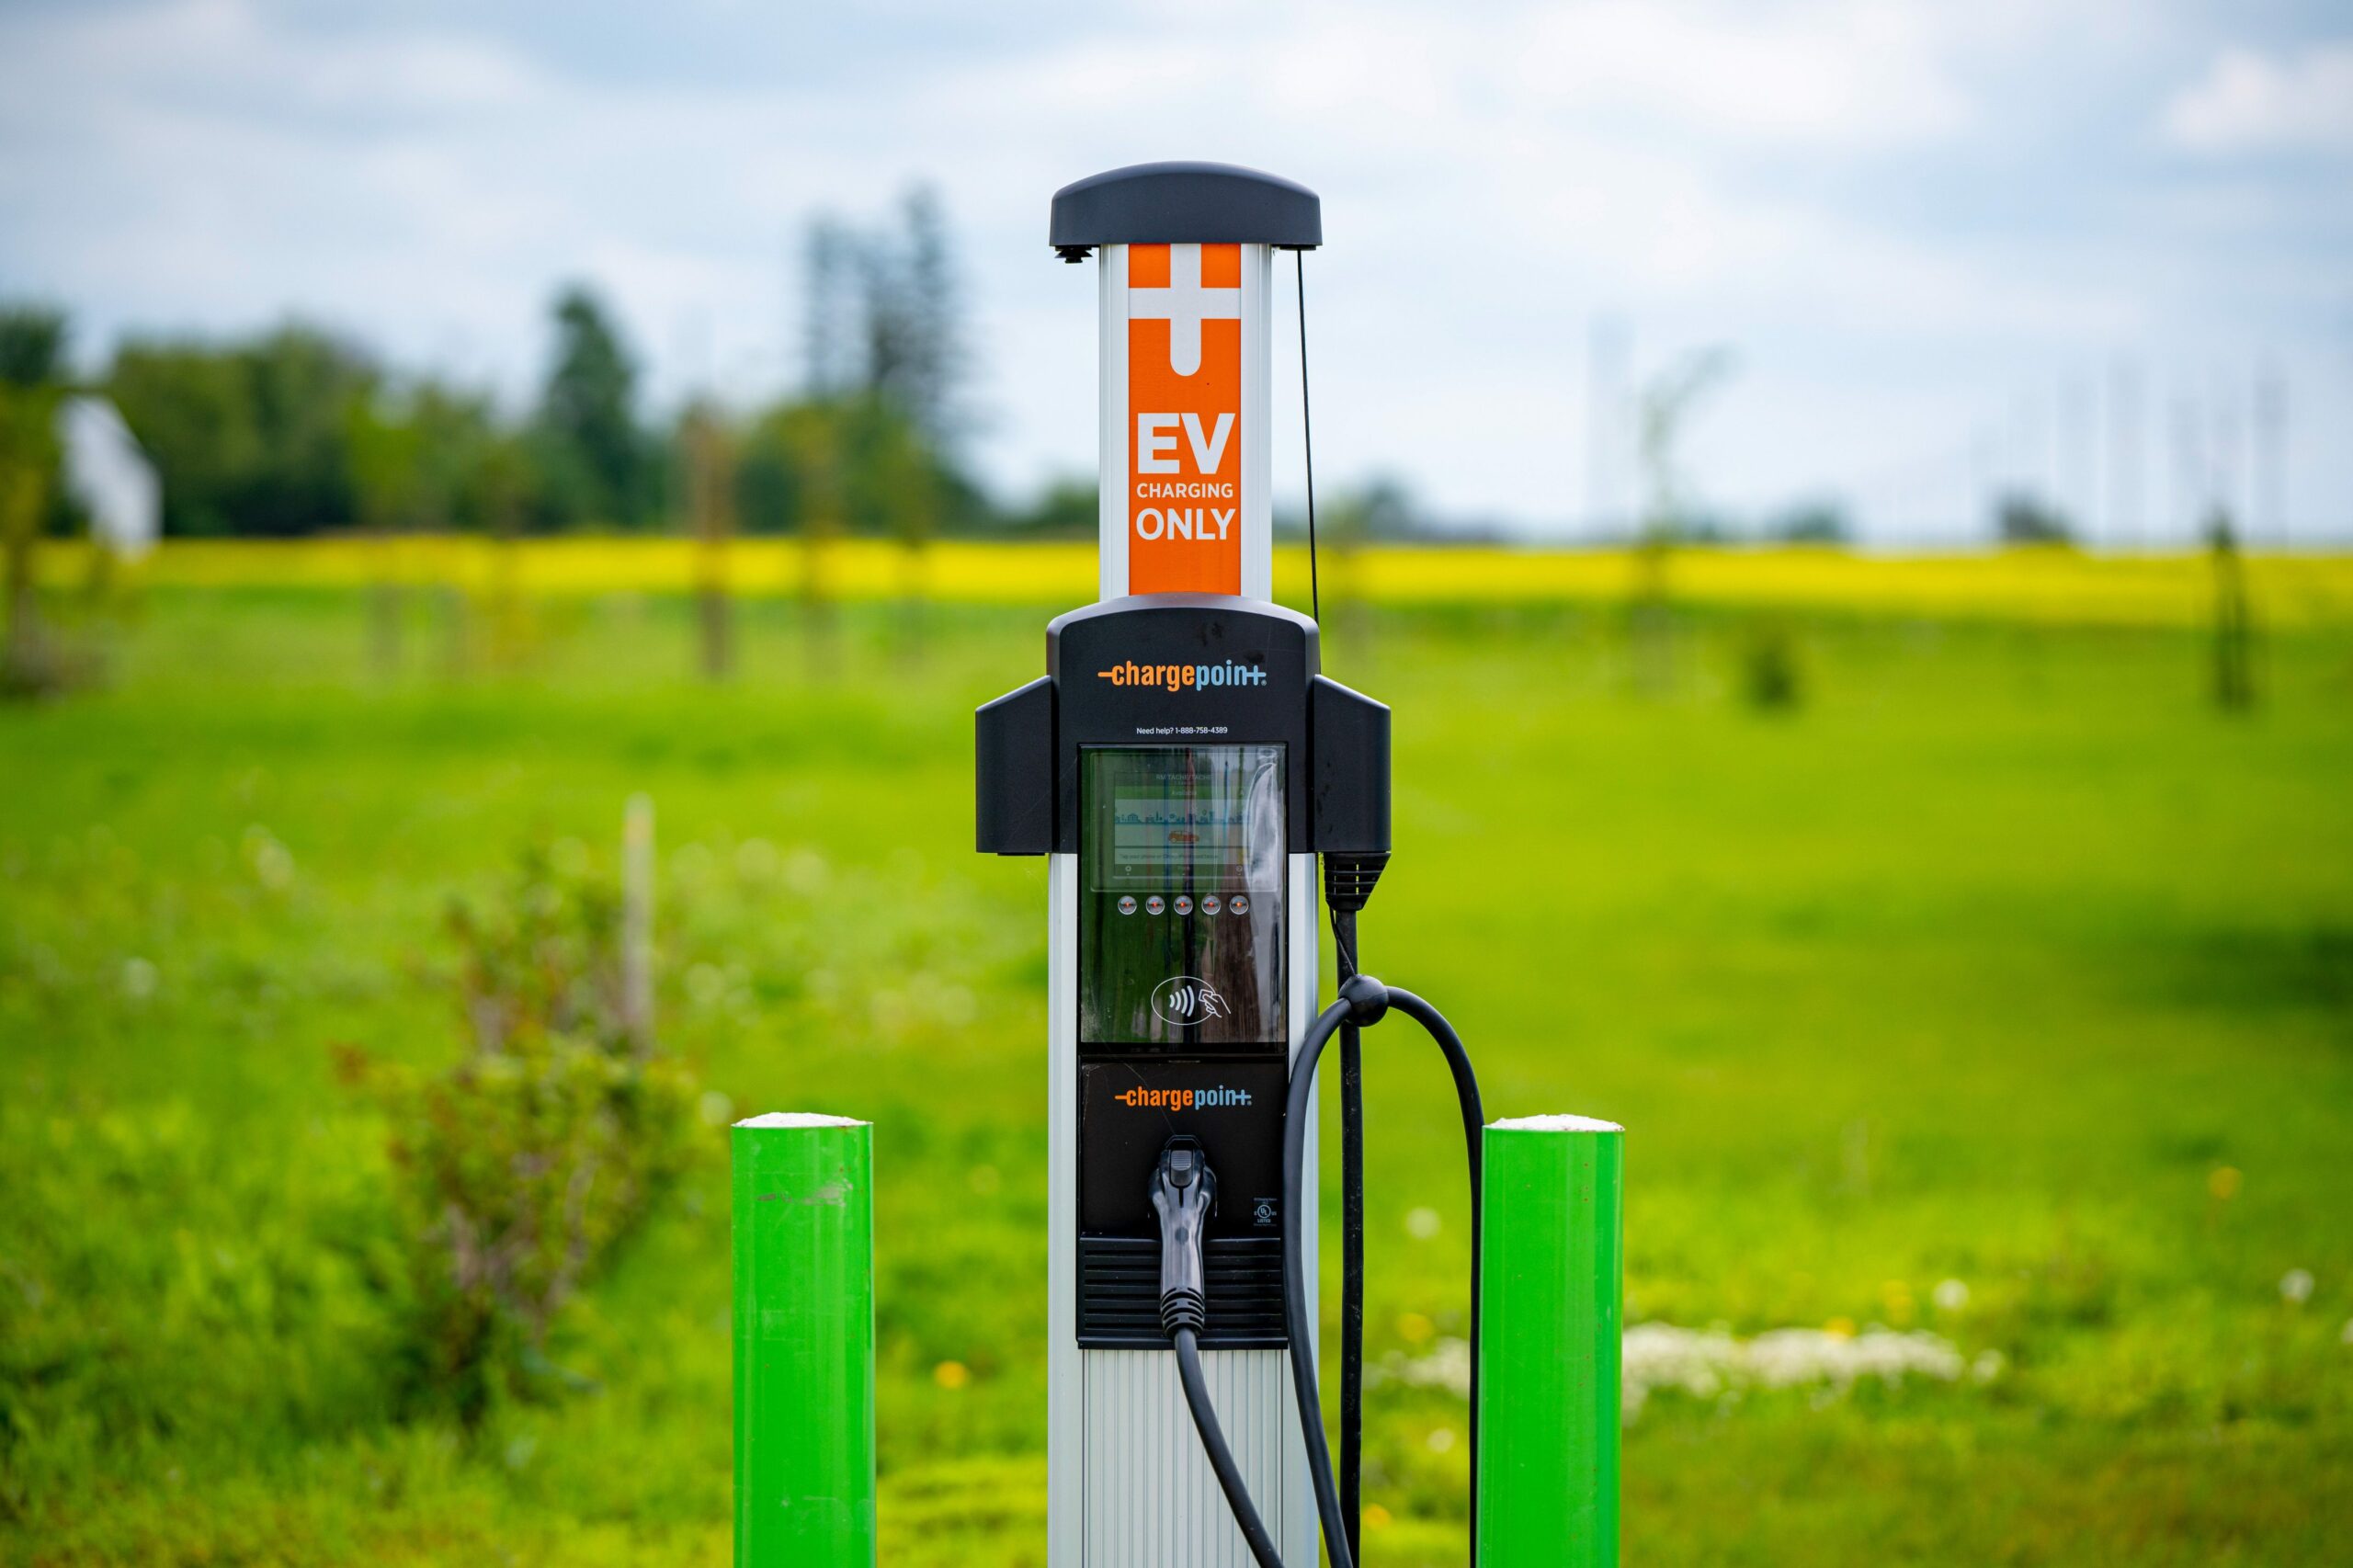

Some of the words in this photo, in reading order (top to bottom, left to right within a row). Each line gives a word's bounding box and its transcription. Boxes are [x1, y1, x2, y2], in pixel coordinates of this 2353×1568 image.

[1137, 413, 1236, 474] EV
[1136, 483, 1233, 498] CHARGING
[1136, 507, 1236, 540] ONLY
[1155, 727, 1174, 735] help?
[1175, 726, 1228, 734] 1-888-758-4389
